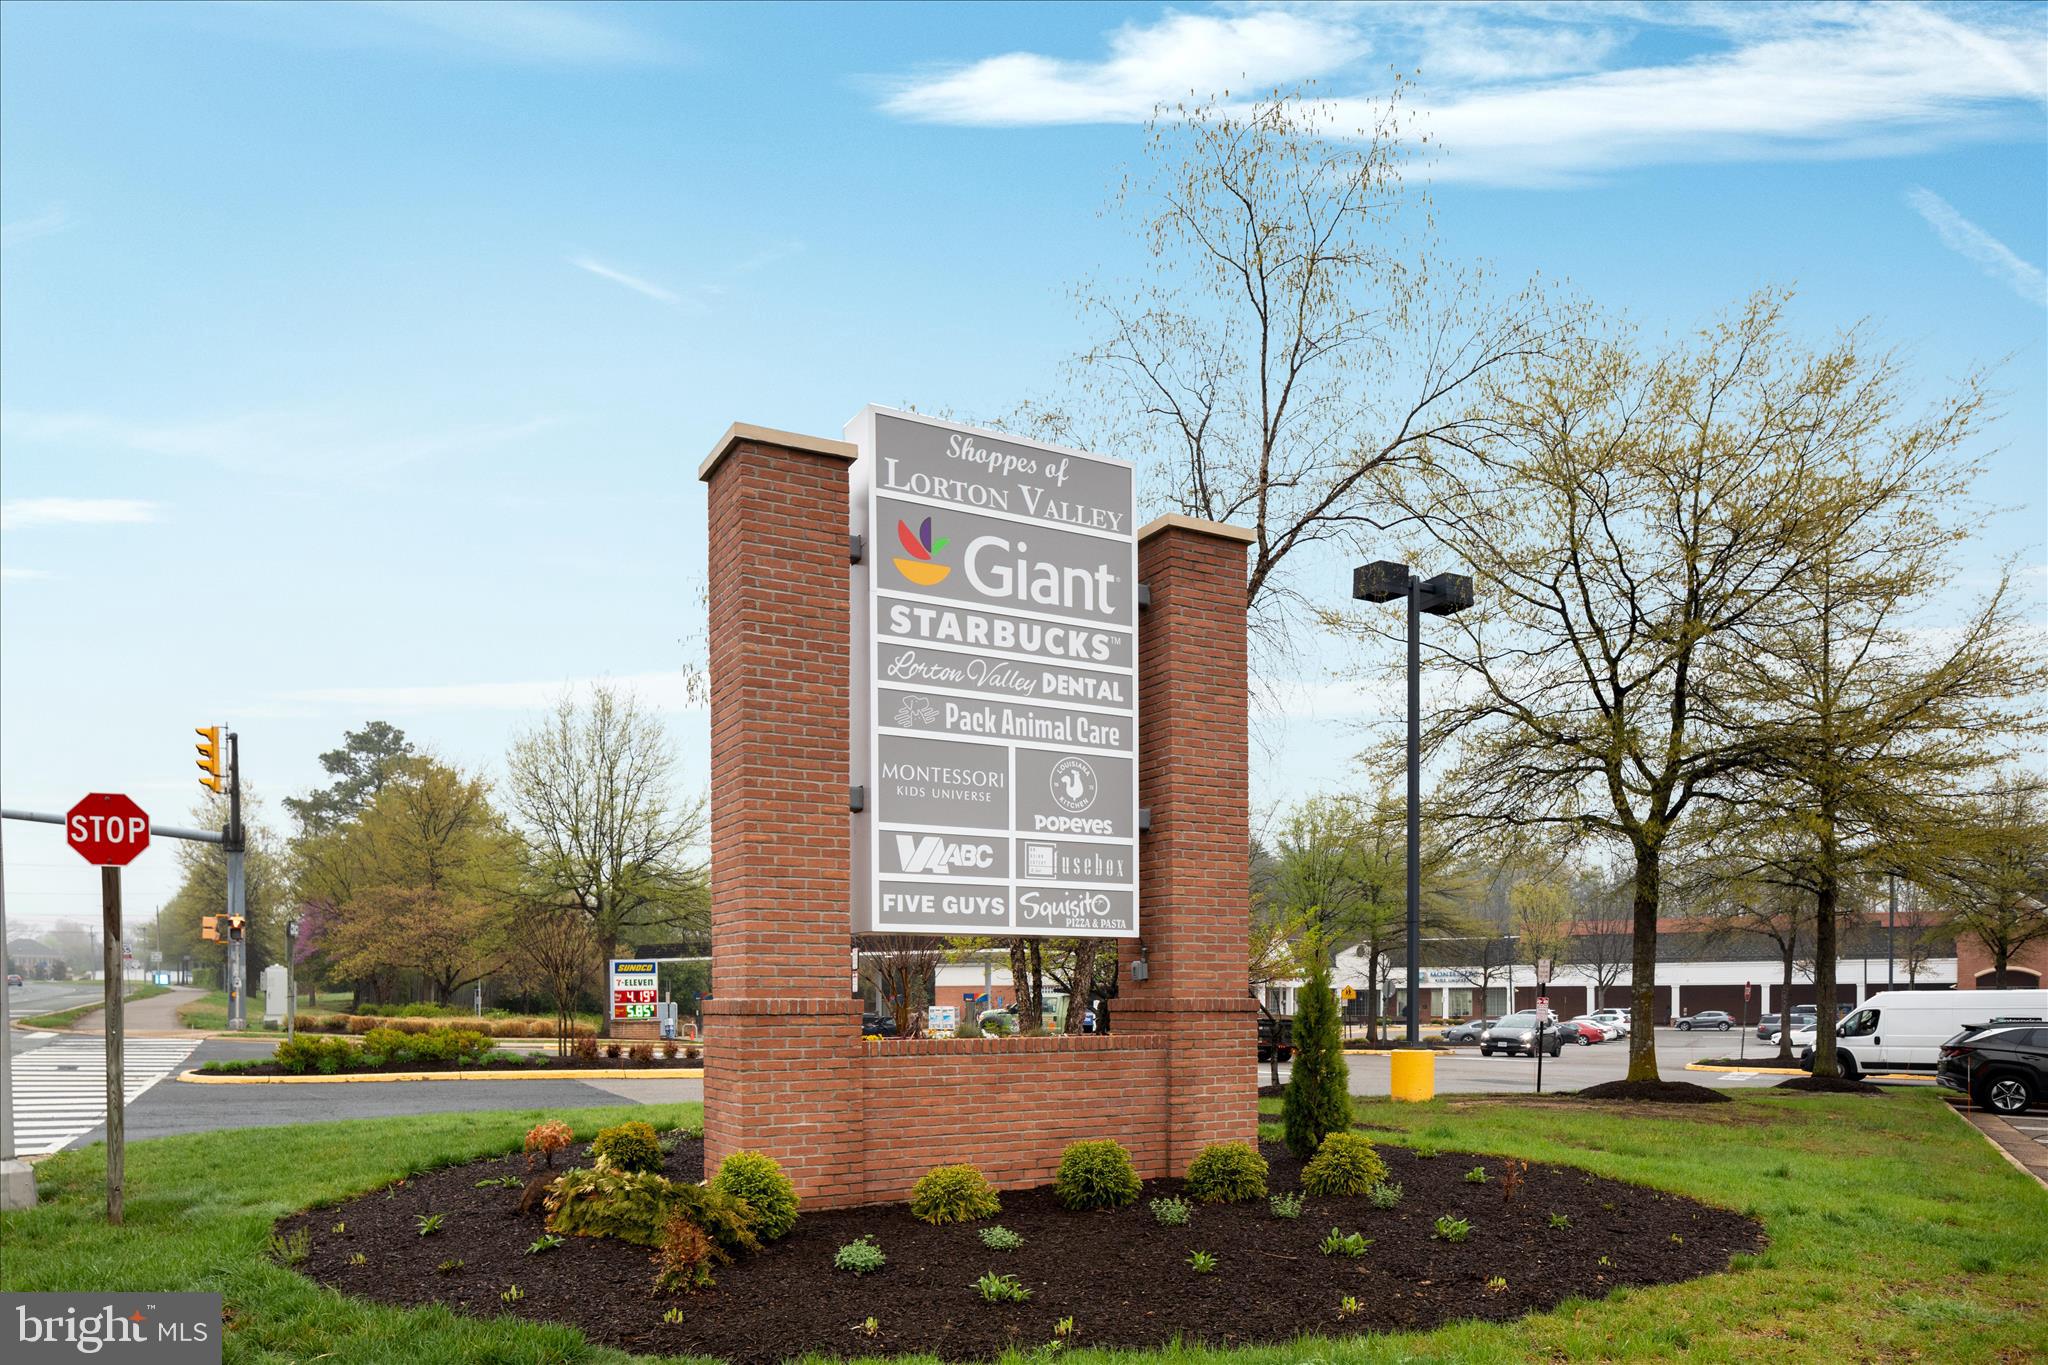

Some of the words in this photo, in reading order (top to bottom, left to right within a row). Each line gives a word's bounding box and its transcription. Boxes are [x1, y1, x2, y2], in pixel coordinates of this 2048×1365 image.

[946, 434, 1038, 476] Shoppes
[1045, 459, 1070, 487] of
[884, 457, 1008, 510] LORTON
[1018, 483, 1124, 532] VALLEY
[964, 535, 1116, 614] Giant
[888, 650, 966, 682] Lorton
[966, 659, 1037, 696] Valley
[1042, 672, 1124, 702] DENTAL
[945, 702, 997, 733] Pack
[1001, 708, 1072, 741] Animal
[1077, 716, 1120, 746] Care
[882, 763, 1004, 788] MONTESSORI
[1056, 760, 1091, 777] LOUISIANA
[896, 785, 926, 798] KIDS
[931, 788, 992, 802] UNIVERSE
[1059, 796, 1089, 809] KITCHEN
[71, 815, 145, 843] STOP
[883, 893, 935, 913] FIVE
[942, 895, 1005, 915] GUYS
[1066, 917, 1091, 928] PIZZA
[1092, 918, 1099, 928] &
[1100, 918, 1127, 929] PASTA
[617, 964, 653, 972] SUNOCO
